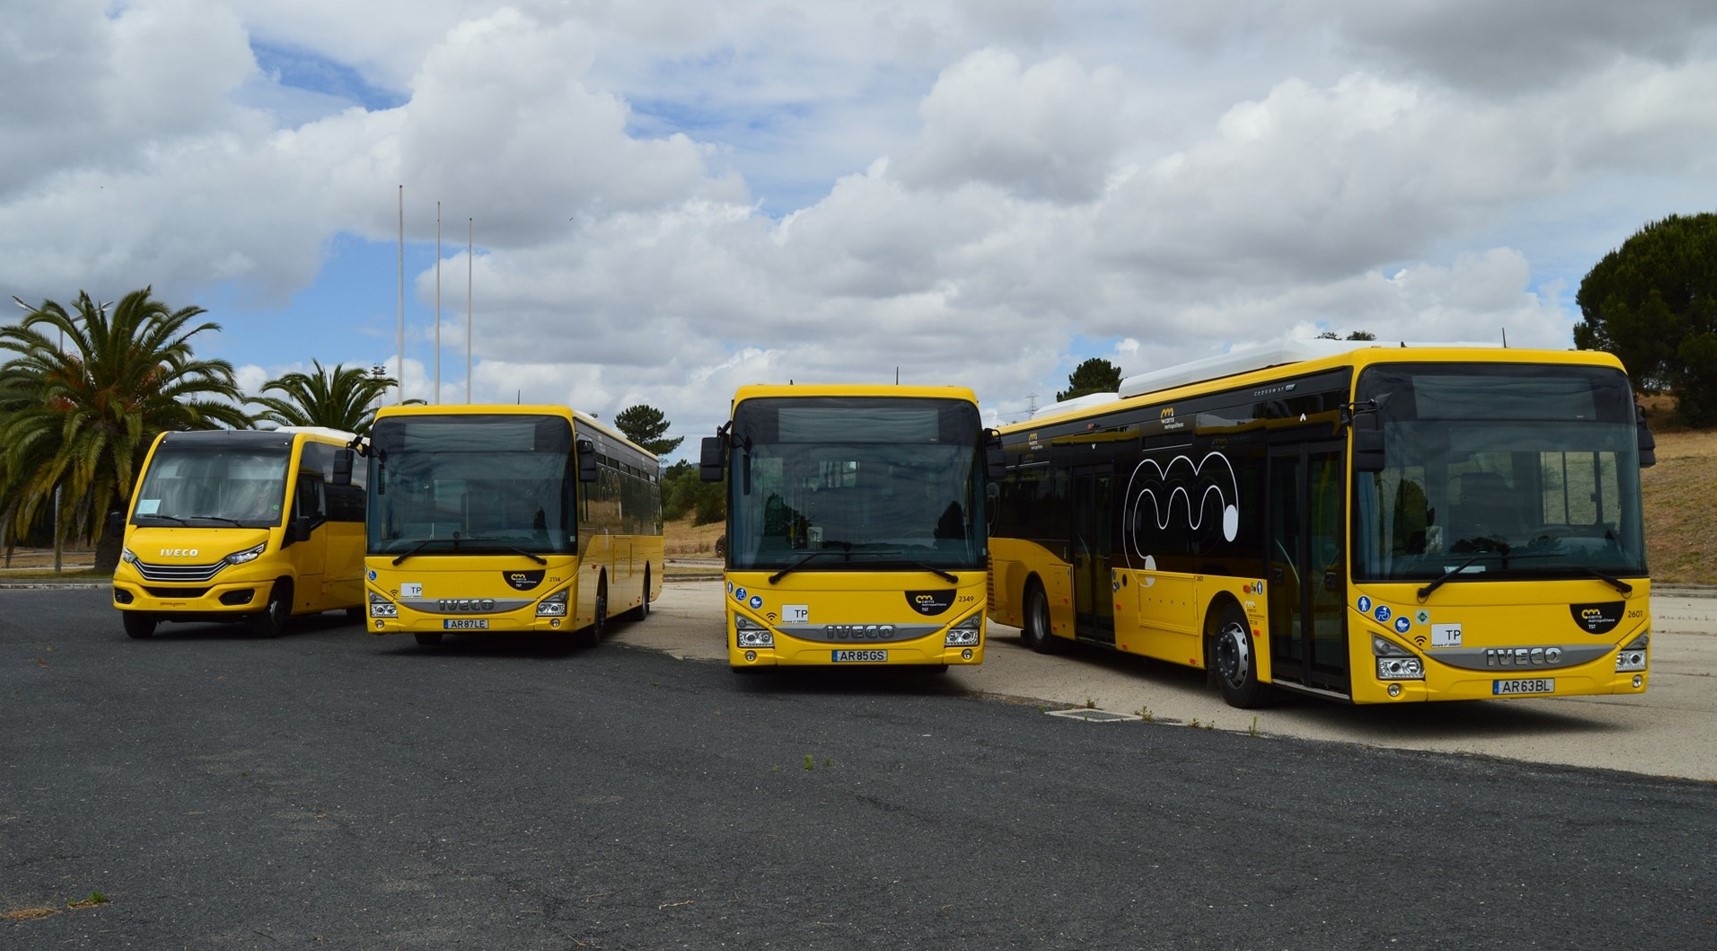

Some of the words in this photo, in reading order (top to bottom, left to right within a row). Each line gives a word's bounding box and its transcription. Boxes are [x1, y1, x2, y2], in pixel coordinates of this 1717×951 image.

[160, 548, 198, 557] IVECO
[411, 586, 422, 594] TP
[958, 595, 975, 603] 2349
[439, 599, 495, 611] IVECO
[794, 609, 808, 618] TP
[1627, 610, 1643, 618] 2601
[826, 624, 896, 640] IVECO
[1445, 629, 1462, 640] TP
[1486, 646, 1562, 666] IVECO
